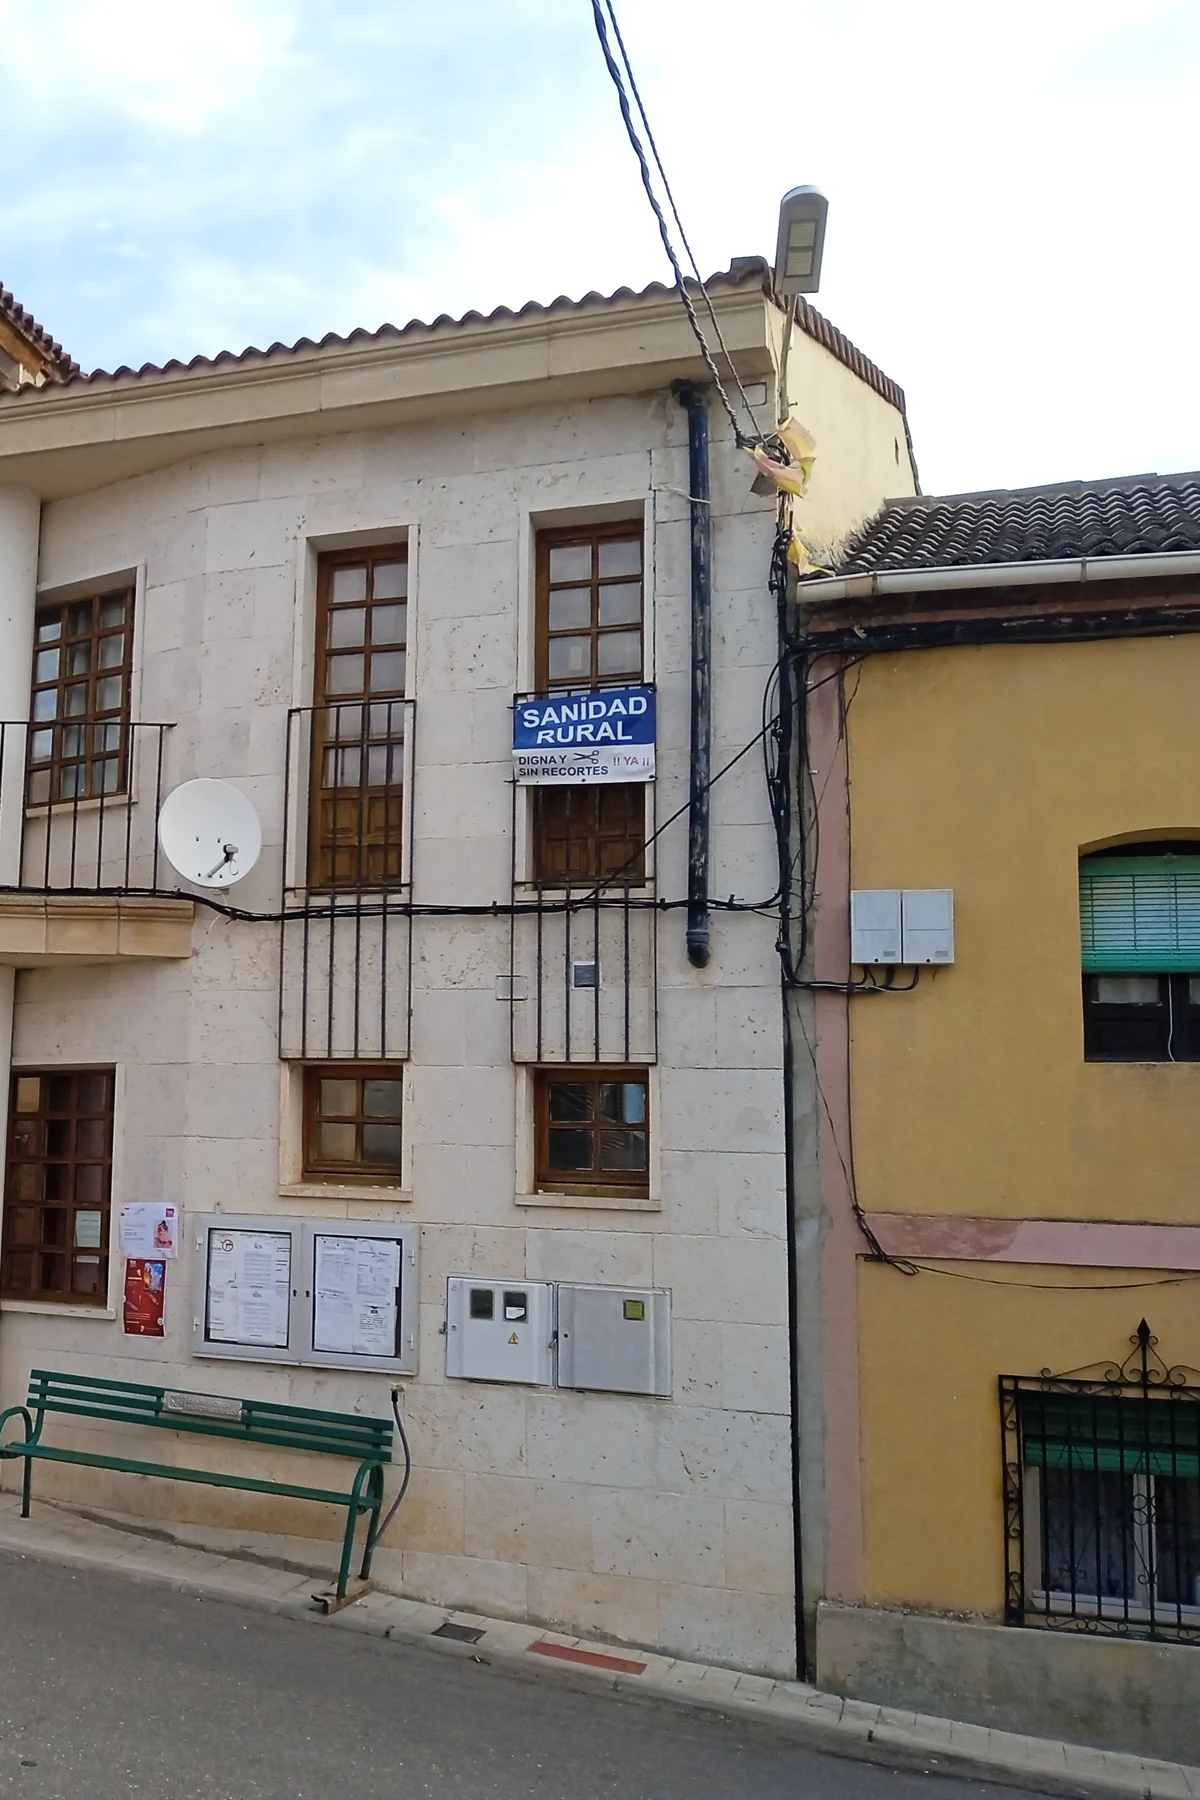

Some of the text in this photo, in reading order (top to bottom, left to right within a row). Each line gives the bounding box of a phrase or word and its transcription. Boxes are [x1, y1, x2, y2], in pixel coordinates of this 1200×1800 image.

[523, 696, 648, 728] SANIDAD
[536, 720, 633, 745] RURAL
[518, 755, 557, 766] DIGNA
[558, 754, 568, 764] Y
[623, 756, 639, 766] YA
[518, 765, 609, 776] SIN RECORTES
